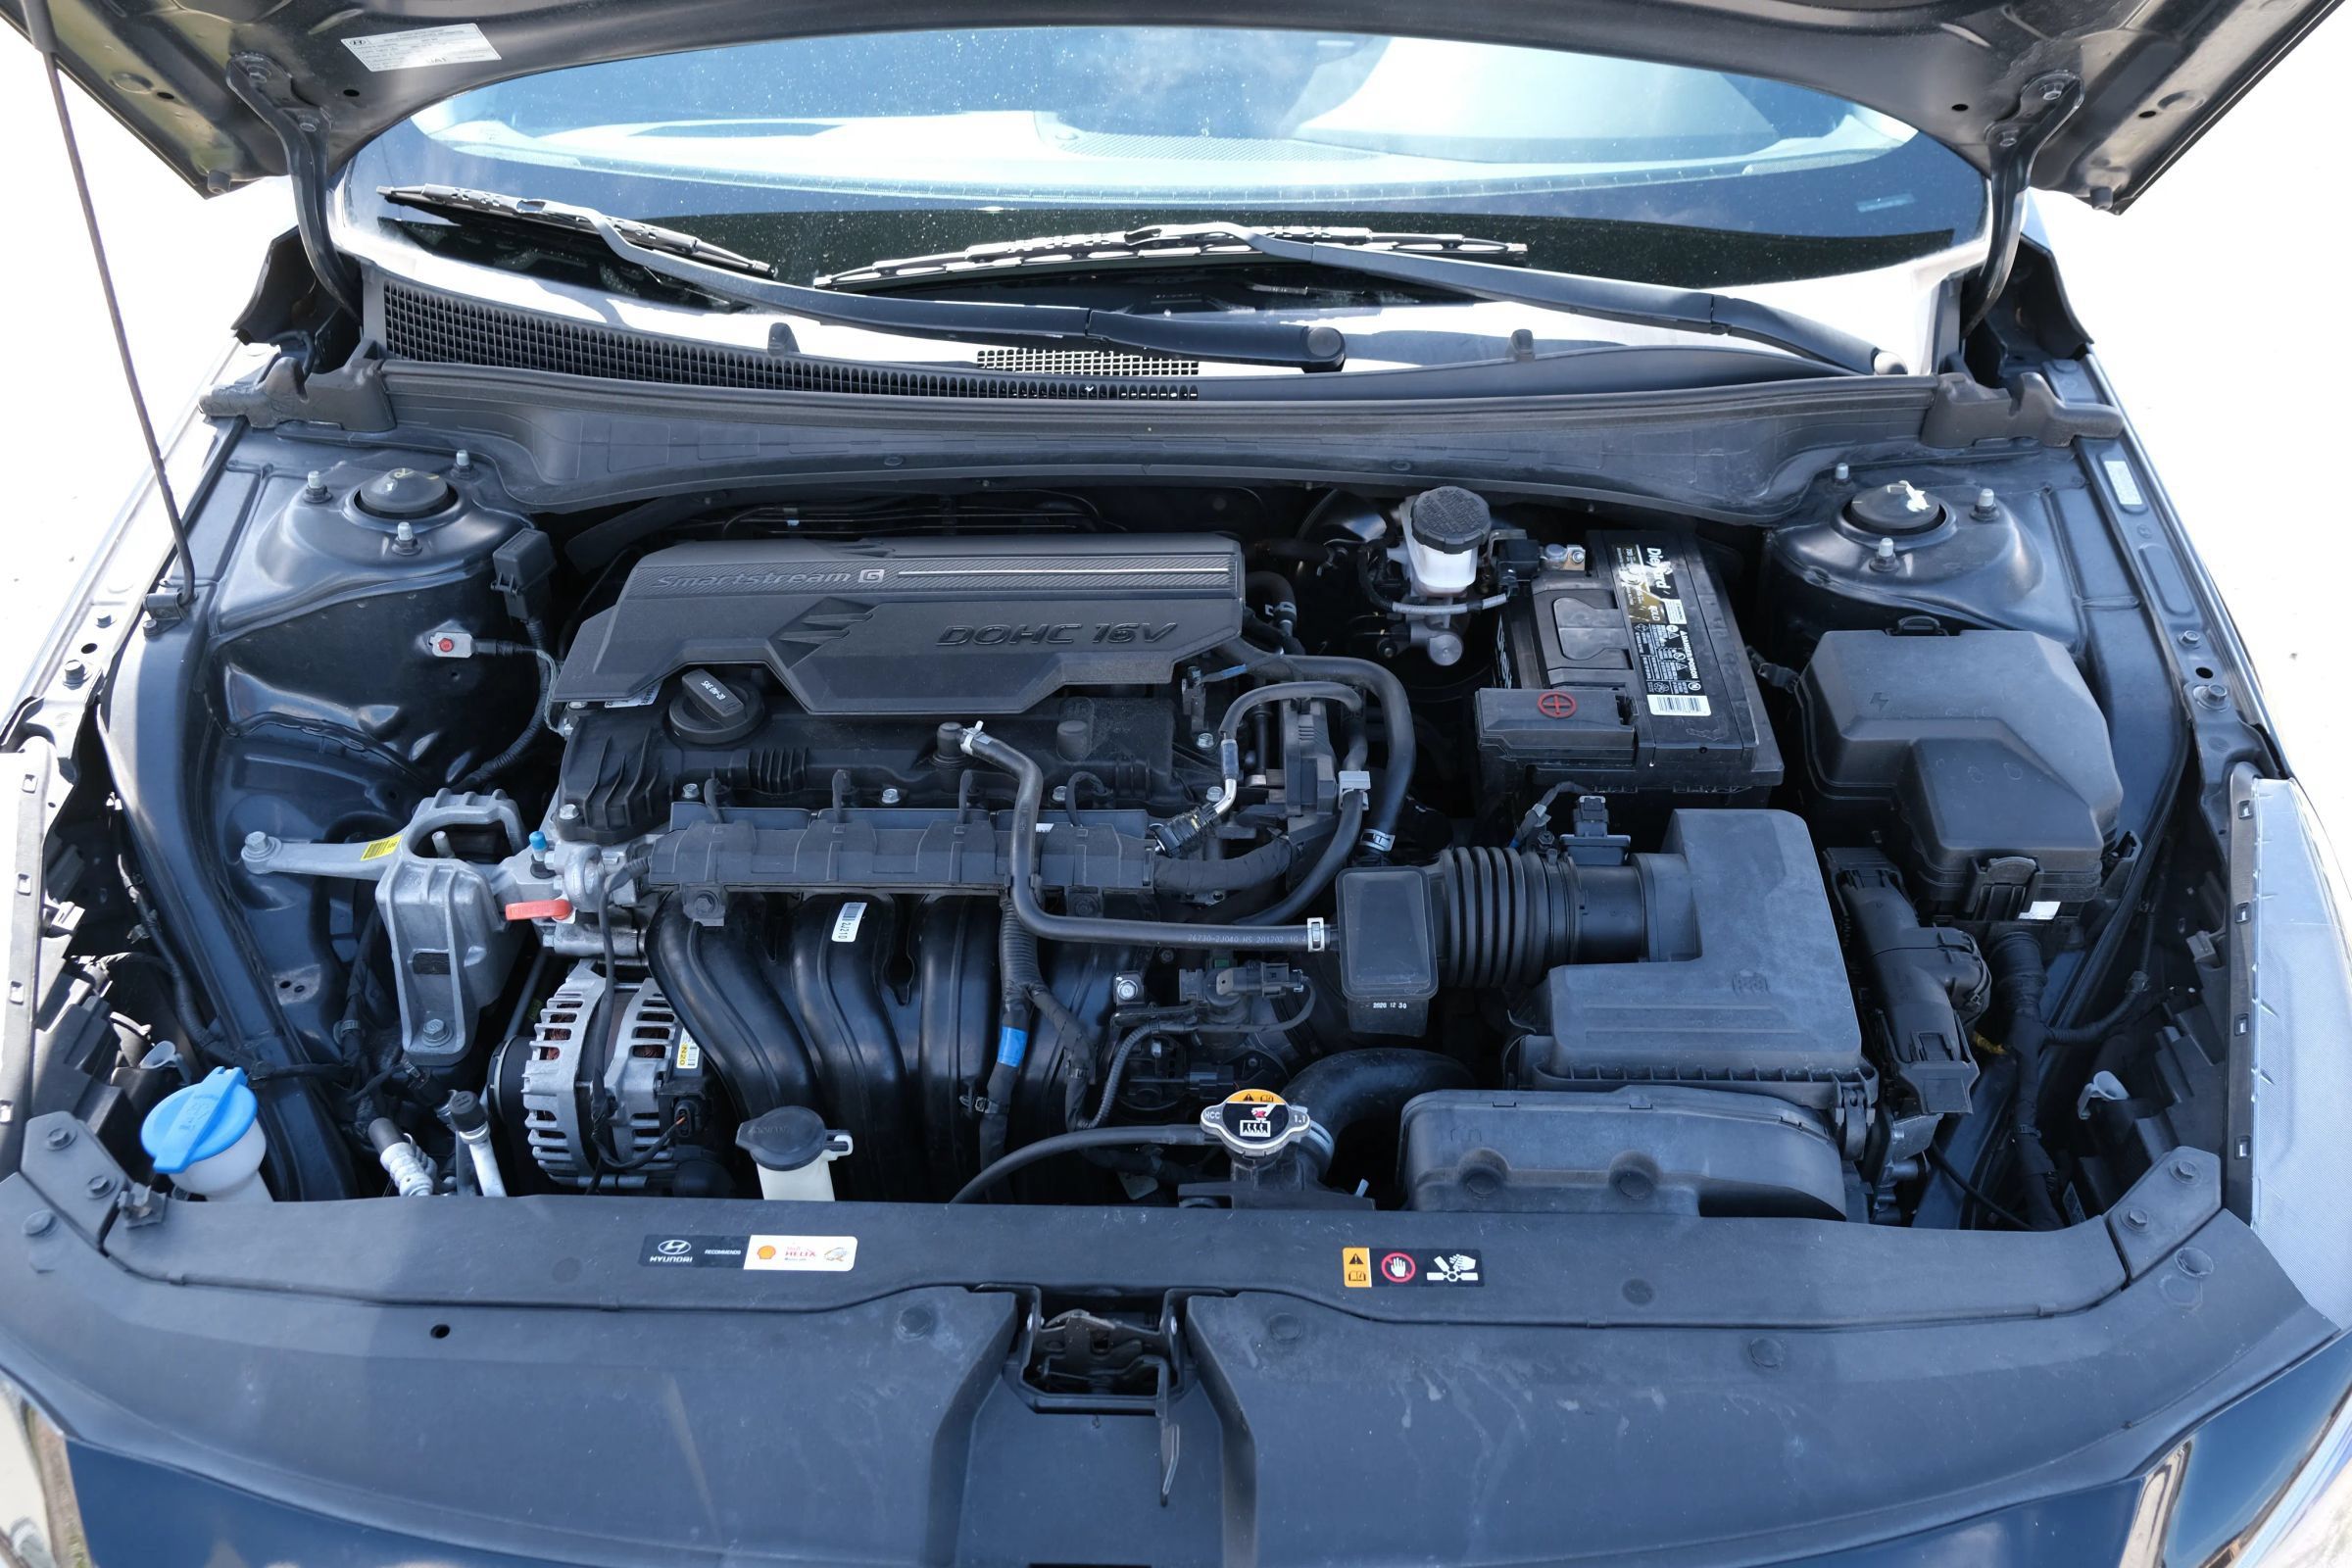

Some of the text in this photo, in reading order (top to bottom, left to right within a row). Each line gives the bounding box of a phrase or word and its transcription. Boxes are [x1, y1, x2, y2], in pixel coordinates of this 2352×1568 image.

[657, 571, 852, 587] Smartstream
[936, 621, 1178, 646] DOHC 16V
[1204, 1110, 1306, 1123] HCC 1.1
